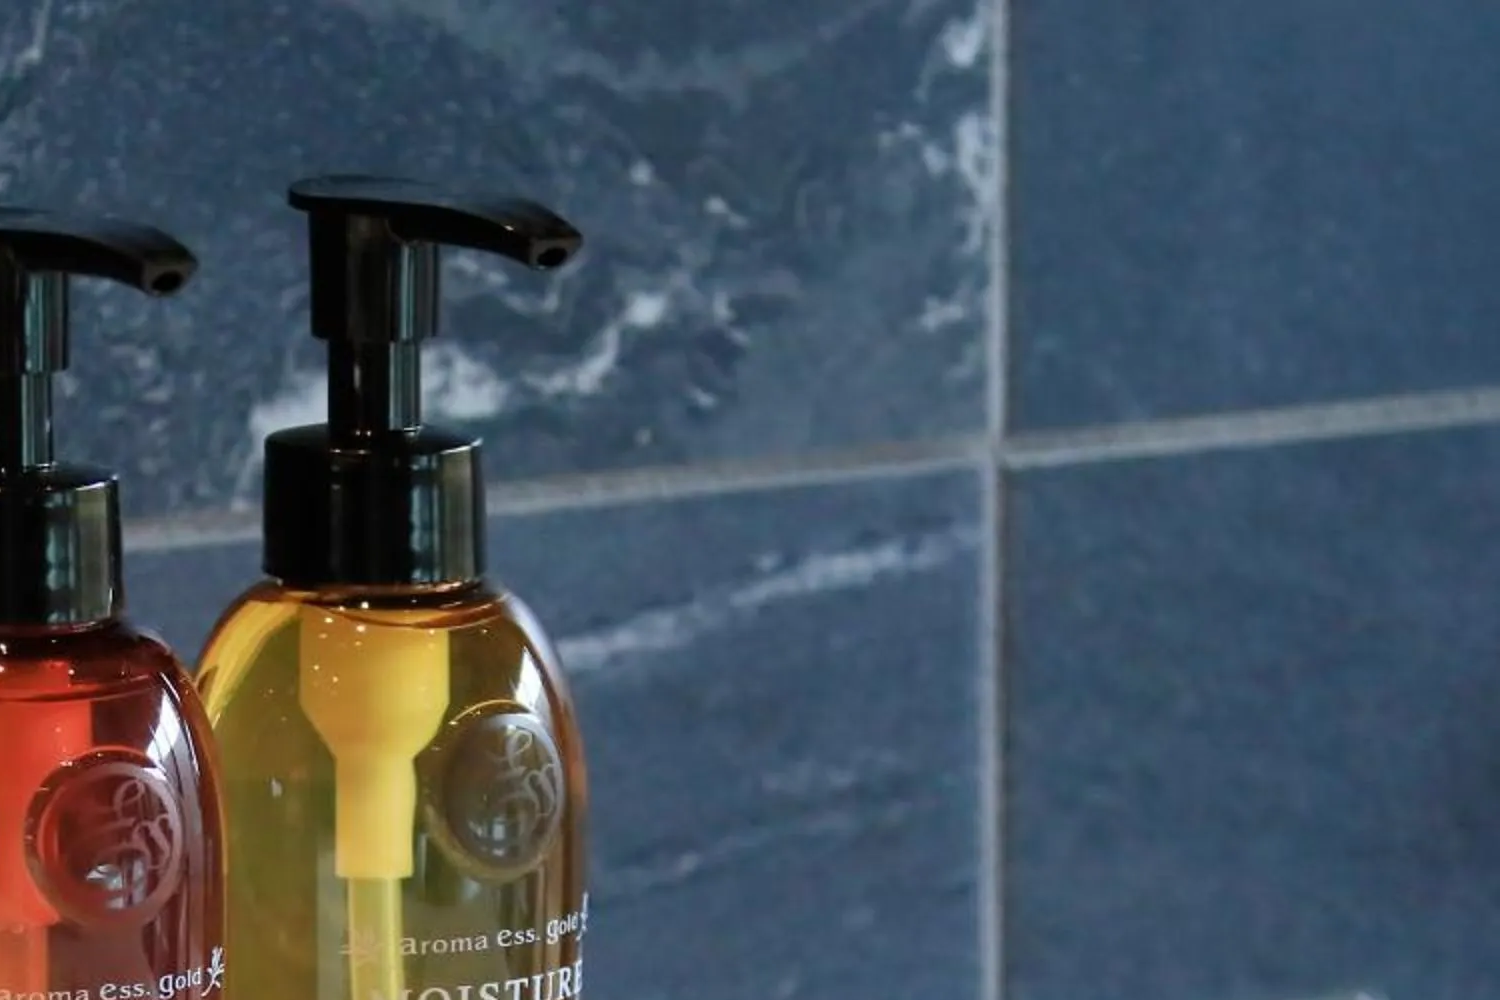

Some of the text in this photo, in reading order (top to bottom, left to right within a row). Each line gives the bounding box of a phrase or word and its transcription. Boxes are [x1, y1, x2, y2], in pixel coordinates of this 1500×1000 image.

[400, 934, 489, 956] aroma
[497, 927, 541, 948] ess.
[100, 982, 152, 1000] ess.
[158, 966, 202, 1000] gold
